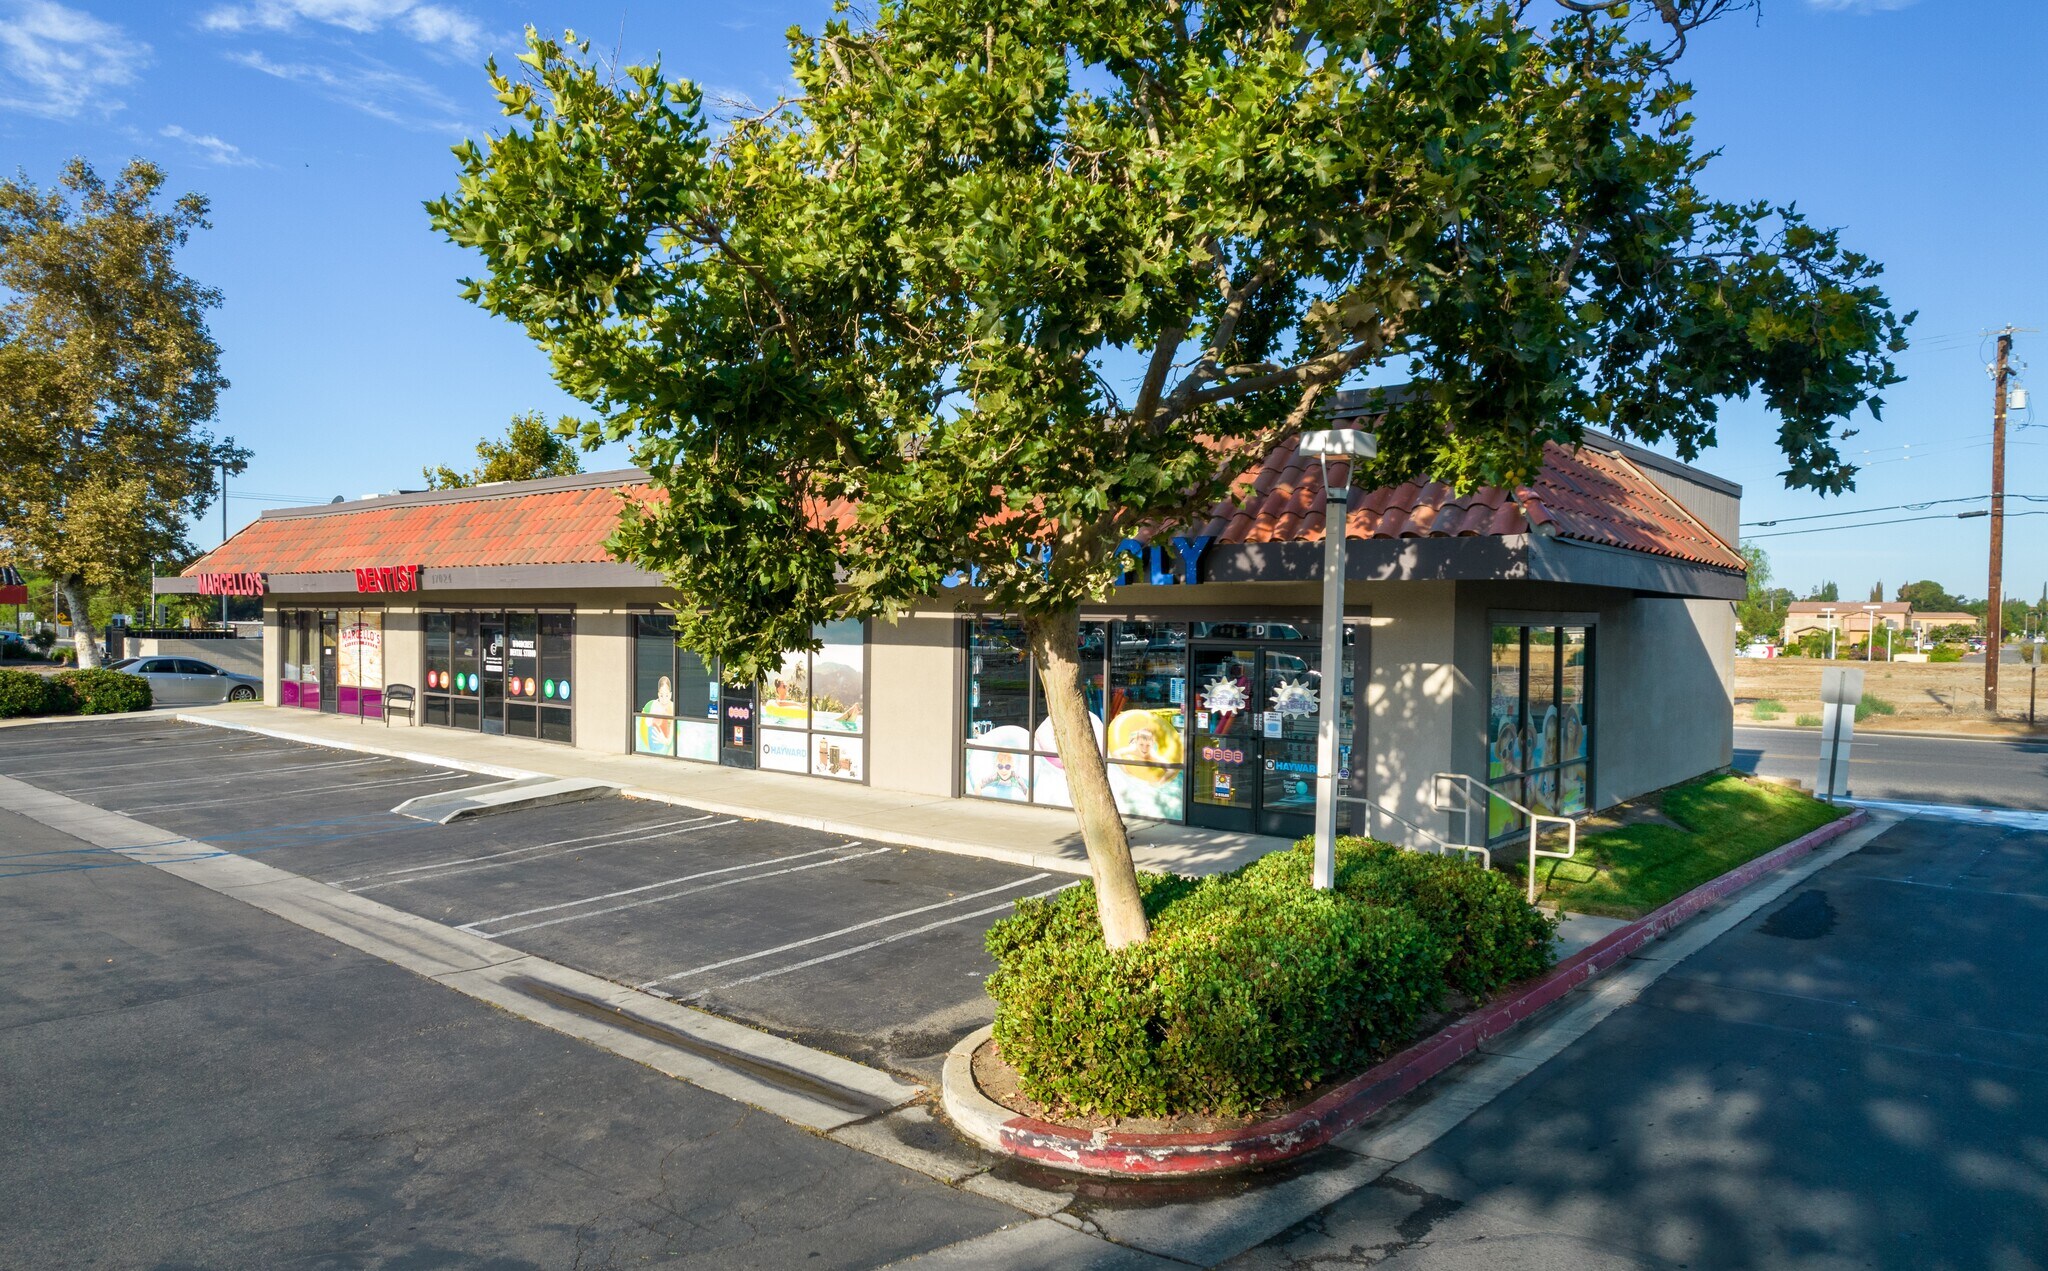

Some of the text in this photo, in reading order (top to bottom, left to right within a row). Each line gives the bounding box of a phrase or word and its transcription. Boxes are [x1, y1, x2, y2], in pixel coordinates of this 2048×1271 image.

[198, 572, 264, 596] MARCELLO'S
[355, 564, 418, 593] DENTIST
[1256, 625, 1265, 636] D
[770, 745, 807, 758] HAYWARD
[1275, 761, 1317, 773] HAYWAR
